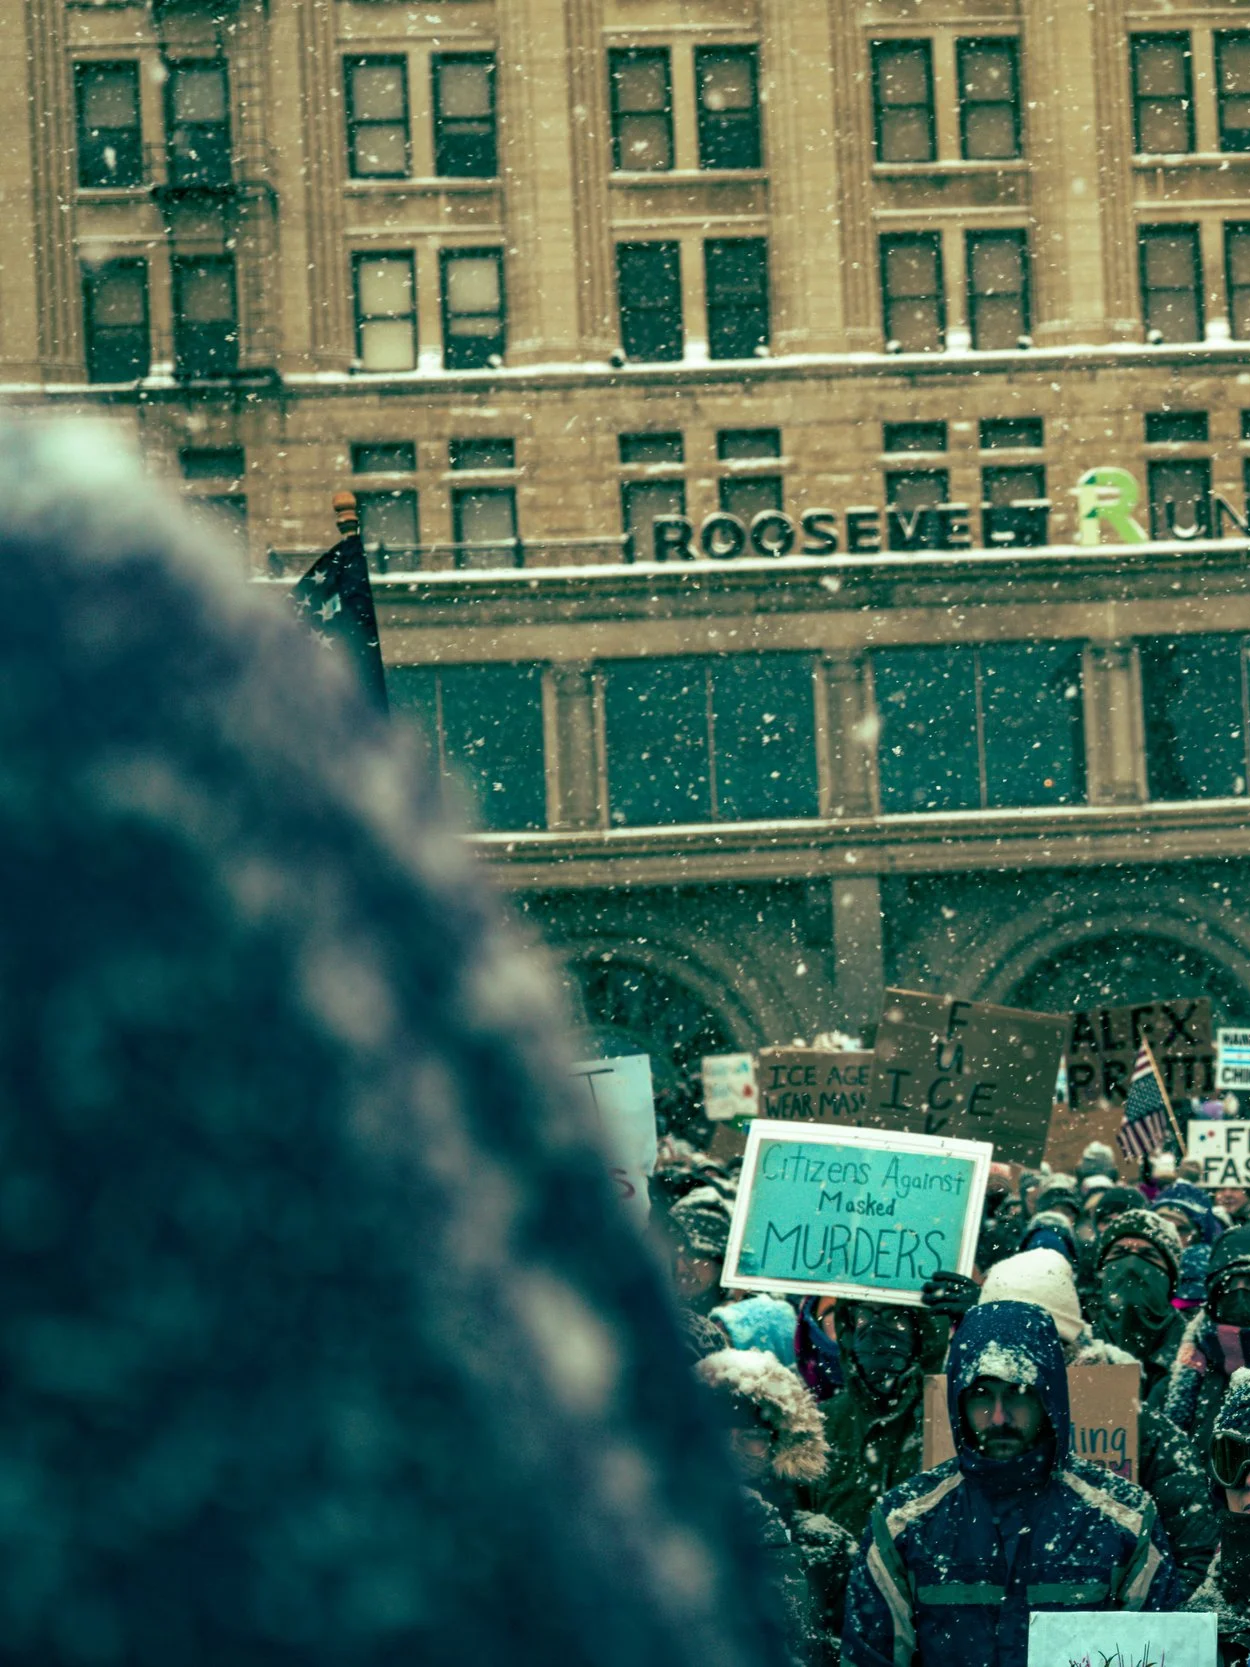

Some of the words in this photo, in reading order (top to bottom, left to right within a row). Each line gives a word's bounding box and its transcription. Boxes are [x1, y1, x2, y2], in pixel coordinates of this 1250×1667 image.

[1070, 1003, 1203, 1054] ALEX
[768, 1065, 816, 1091] ICE
[827, 1065, 870, 1087] AGE
[879, 1068, 997, 1117] ICE
[1068, 1054, 1214, 1109] PRTTI
[766, 1092, 815, 1118] WEAR
[762, 1143, 872, 1185] Citizens
[881, 1155, 966, 1198] Against
[818, 1190, 896, 1216] Masked
[760, 1221, 946, 1280] MURDERS
